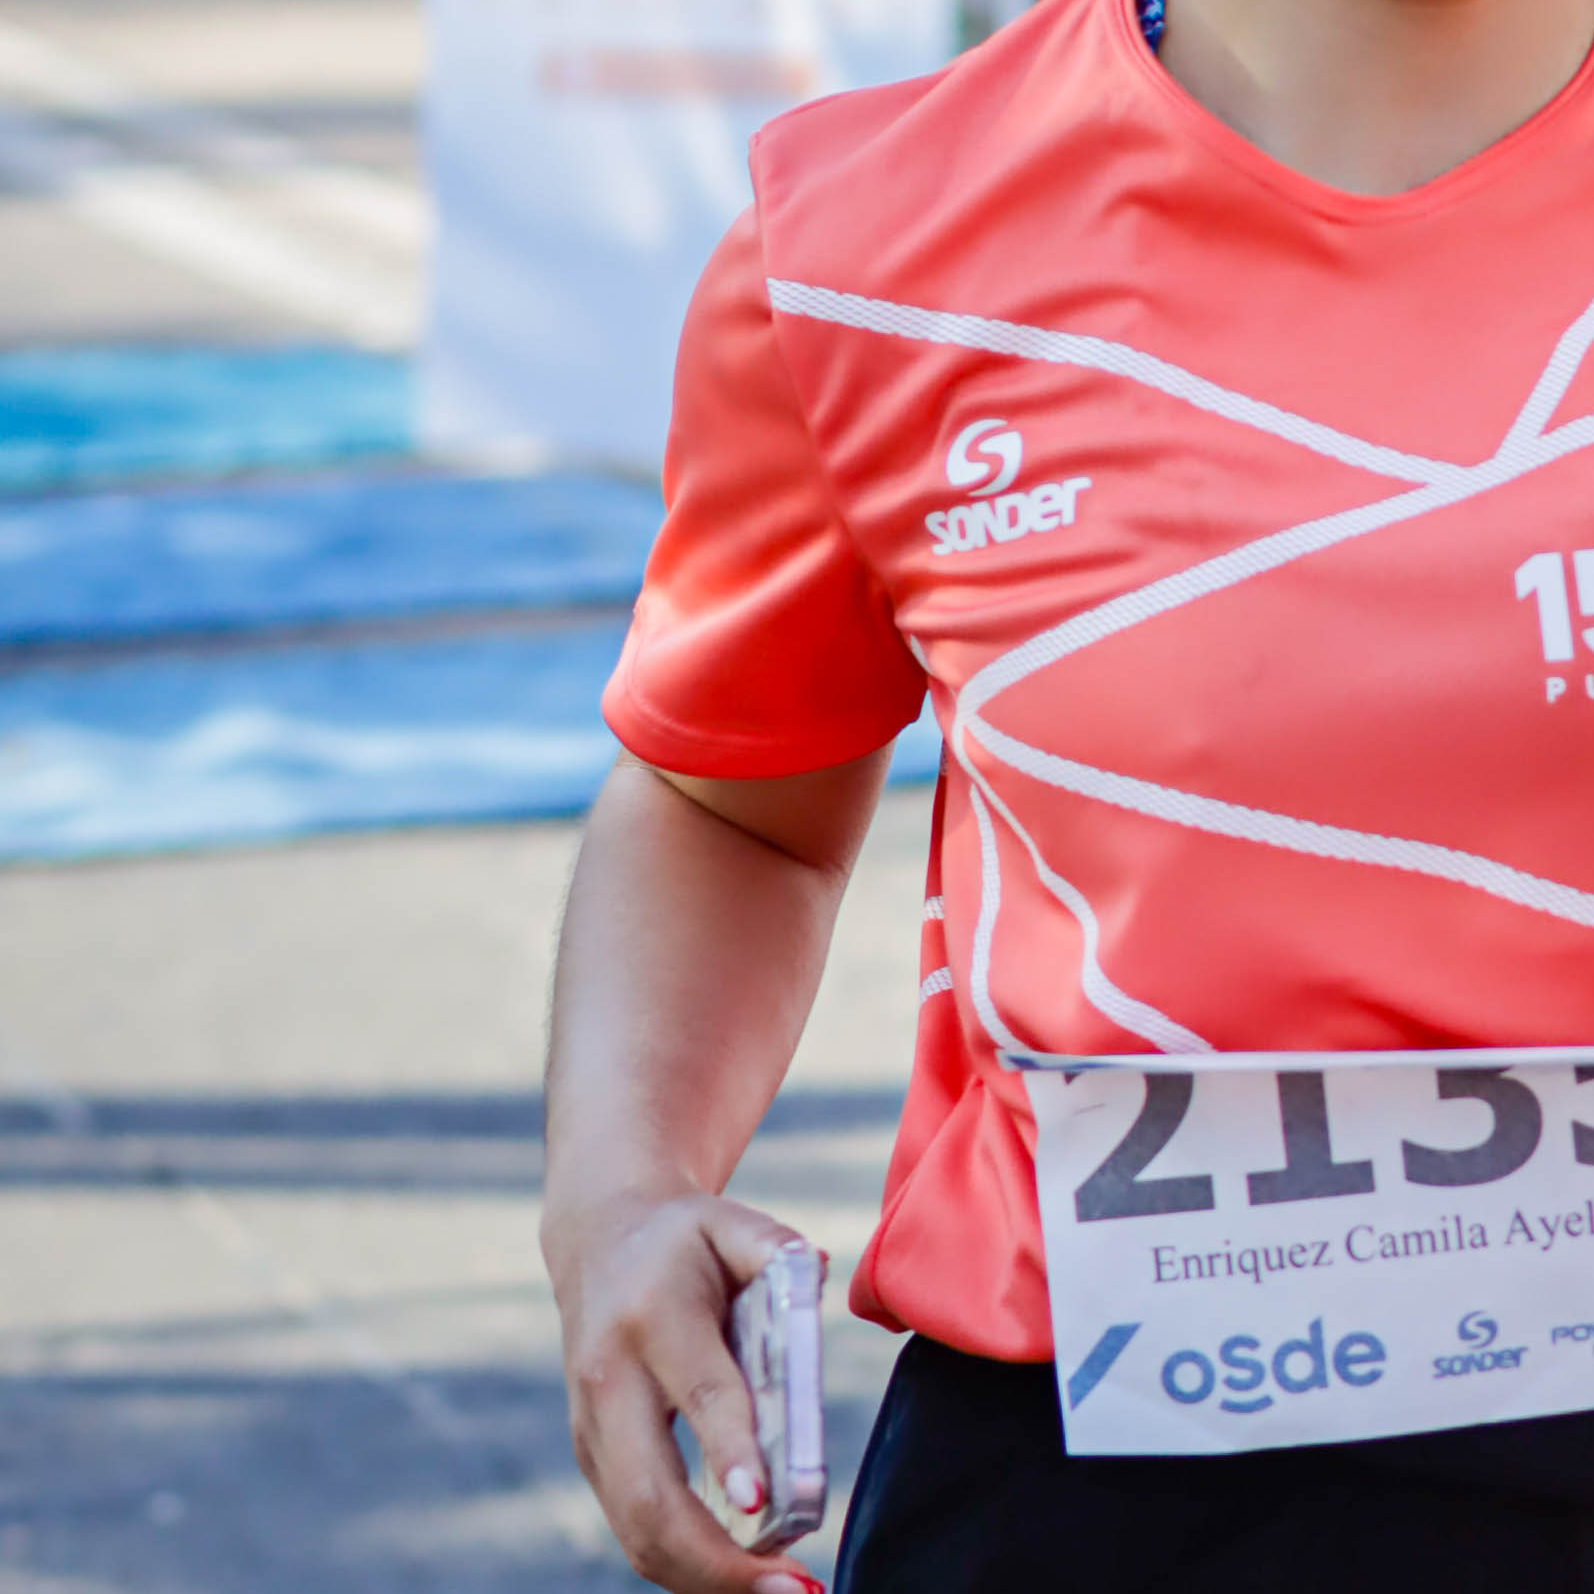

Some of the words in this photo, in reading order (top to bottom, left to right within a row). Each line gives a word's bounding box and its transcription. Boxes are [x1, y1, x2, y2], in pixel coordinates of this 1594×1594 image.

[1152, 1236, 1333, 1284] Enriquez
[1345, 1214, 1488, 1264] Camila
[1160, 1316, 1387, 1405] osde
